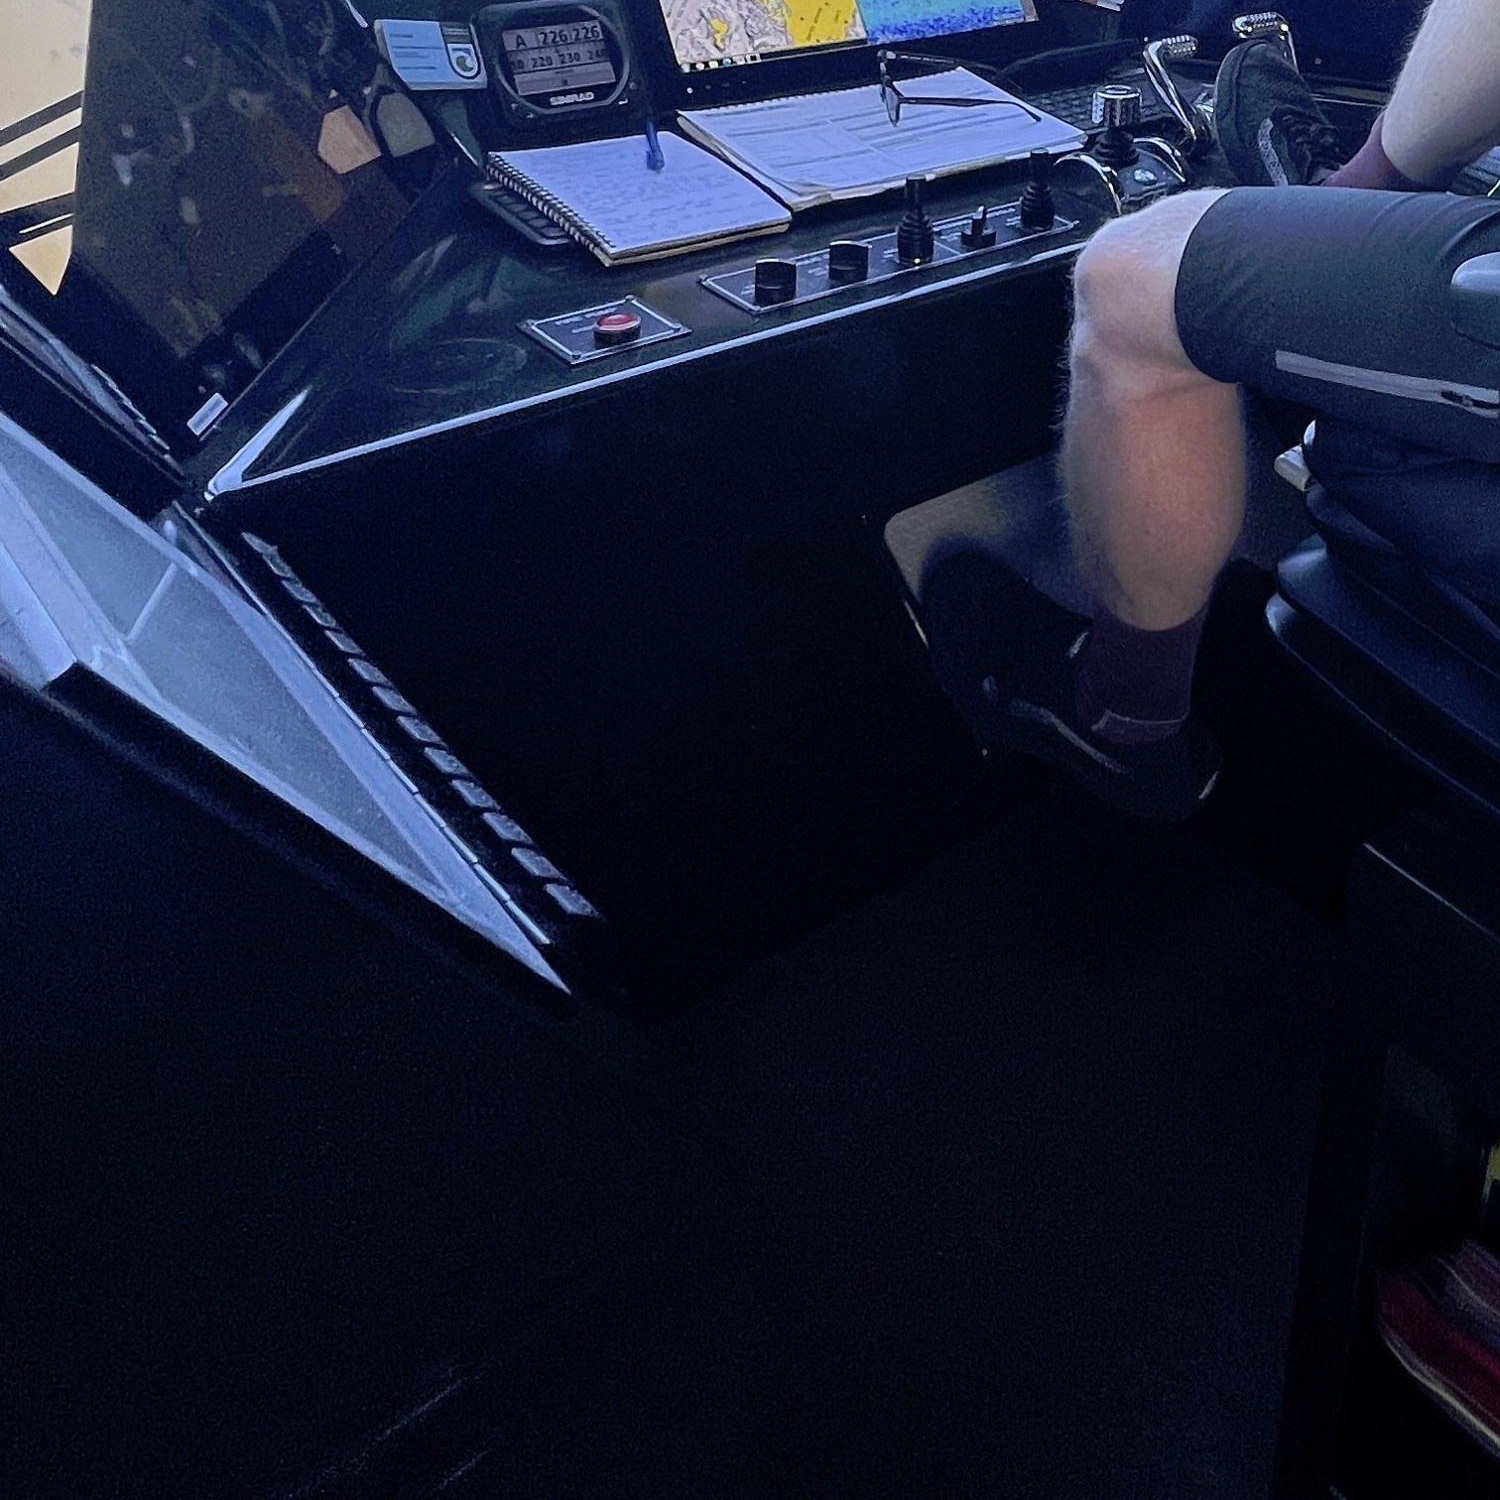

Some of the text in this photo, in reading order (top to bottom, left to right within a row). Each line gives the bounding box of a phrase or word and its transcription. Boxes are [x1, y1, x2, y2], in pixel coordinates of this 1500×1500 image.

[515, 24, 601, 49] A 226 226
[549, 91, 595, 107] SIMRAD
